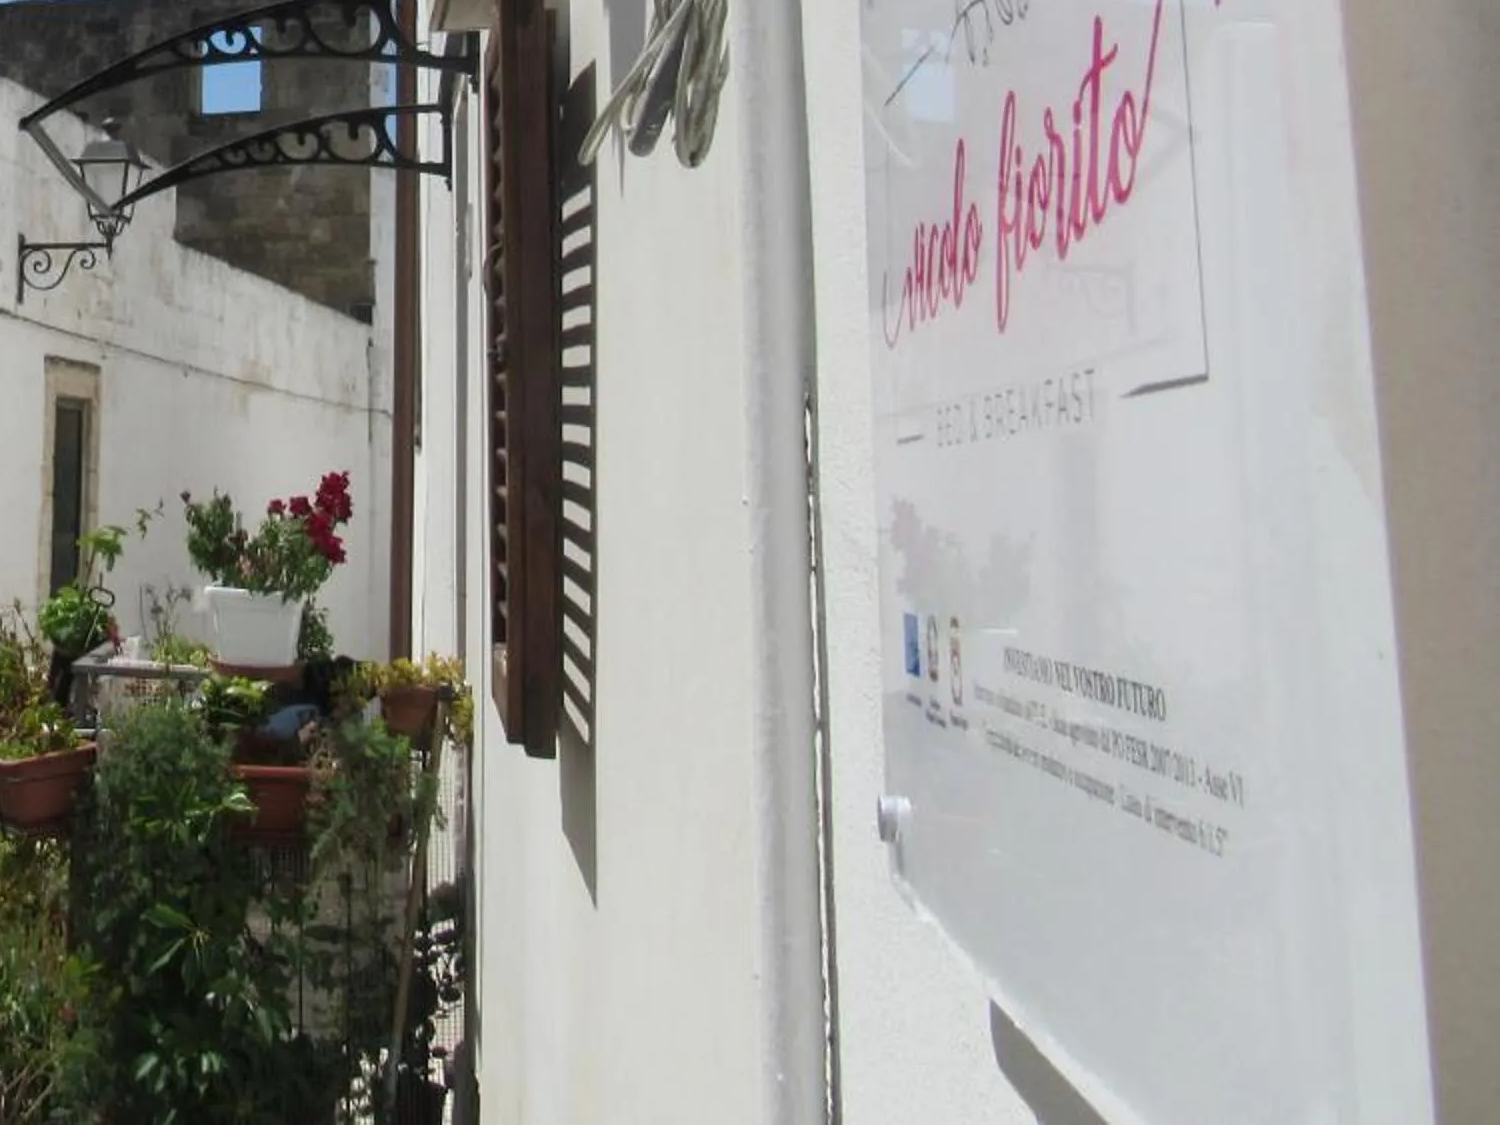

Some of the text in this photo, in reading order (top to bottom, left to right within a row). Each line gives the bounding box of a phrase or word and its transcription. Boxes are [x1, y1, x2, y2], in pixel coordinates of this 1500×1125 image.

[936, 403, 962, 448] BED
[984, 368, 1096, 440] BREAKFAST
[1073, 665, 1115, 706] VOSTRO
[1116, 676, 1167, 722] FUTURO
